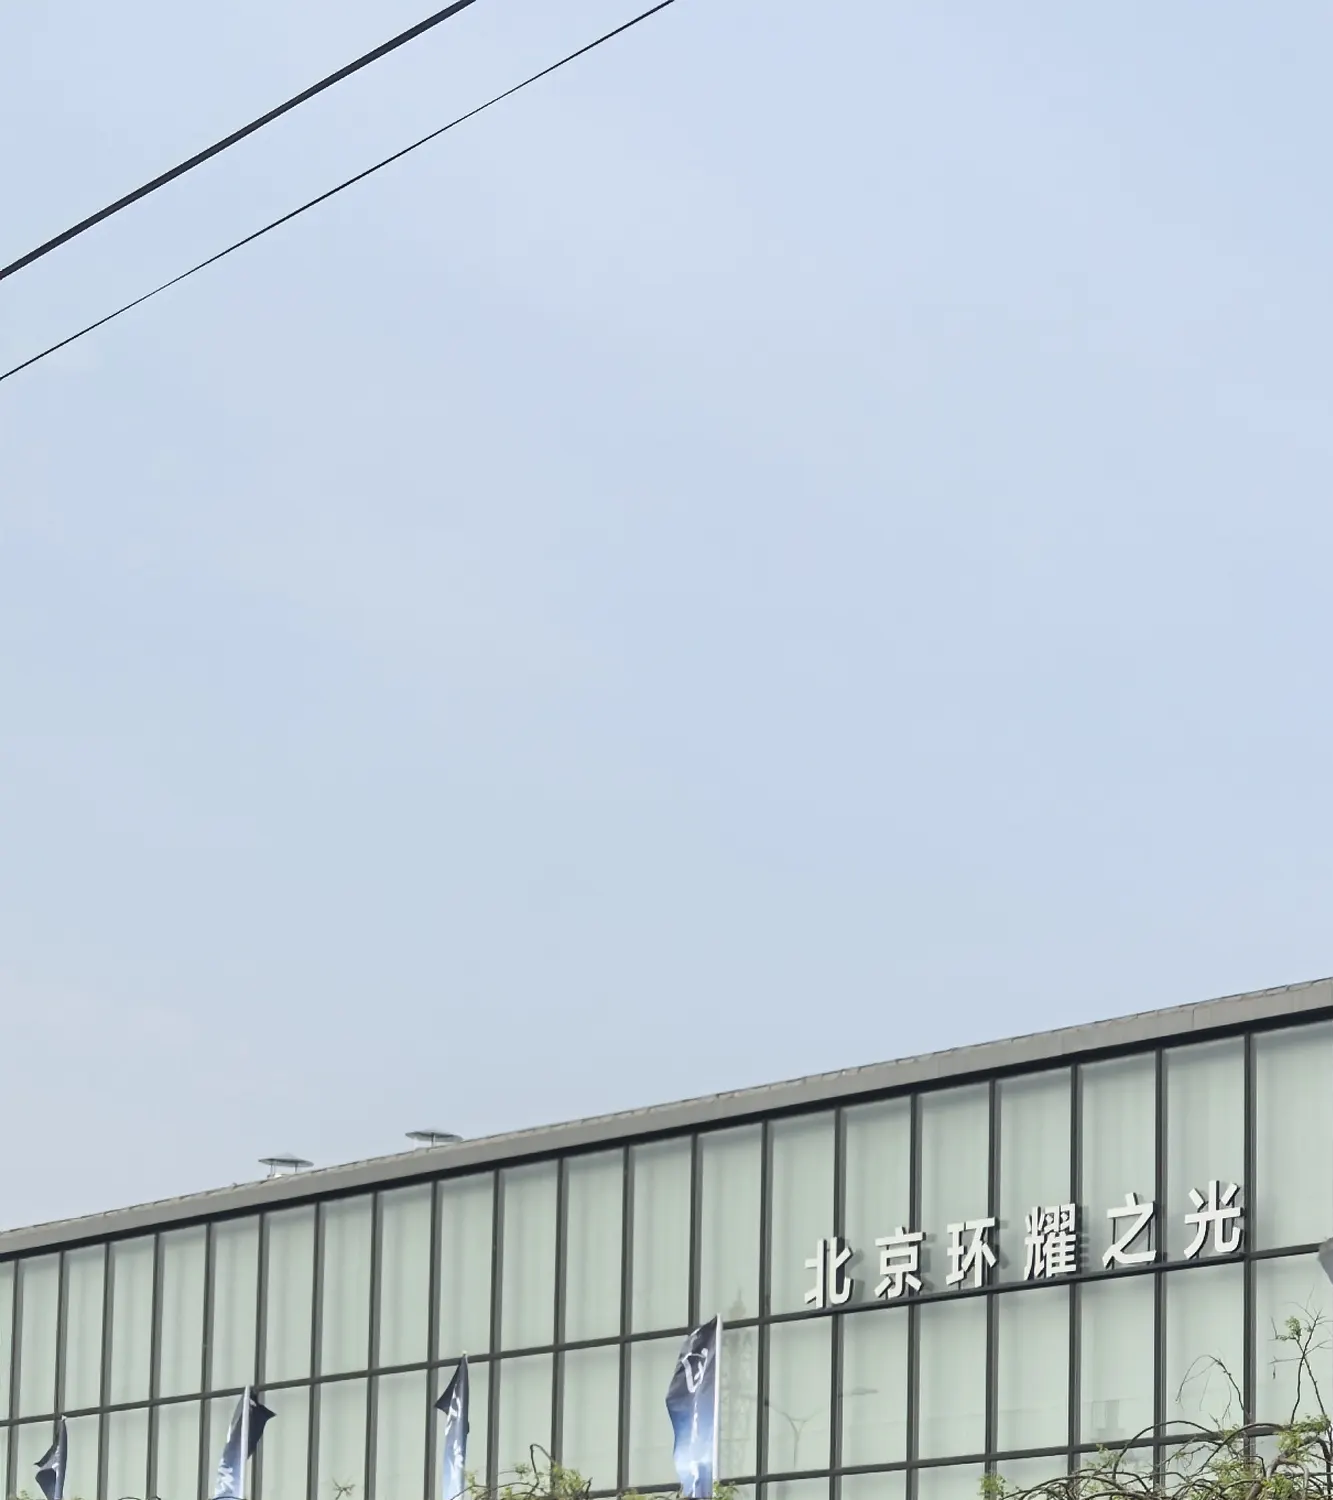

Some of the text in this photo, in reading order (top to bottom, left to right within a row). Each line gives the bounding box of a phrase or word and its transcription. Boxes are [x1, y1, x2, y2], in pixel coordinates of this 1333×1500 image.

[804, 1179, 1242, 1308] 北京环耀之光
